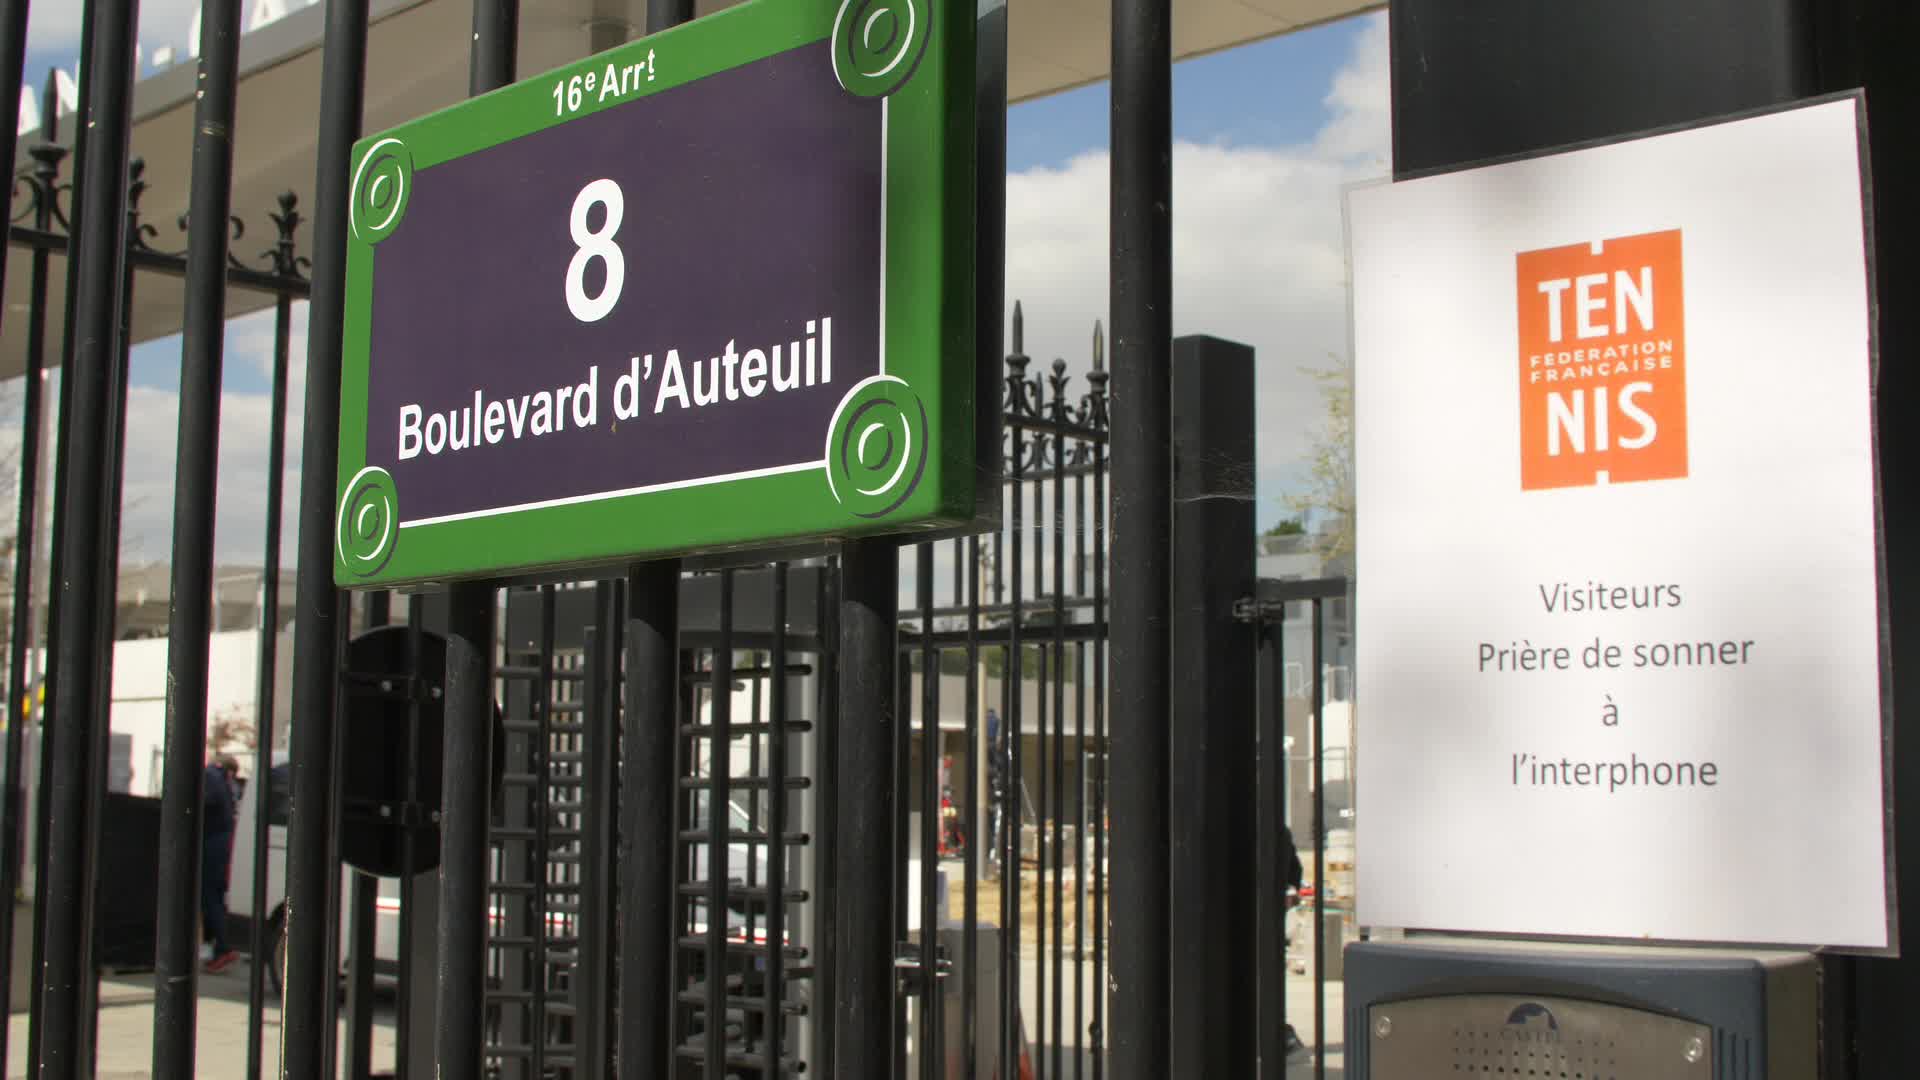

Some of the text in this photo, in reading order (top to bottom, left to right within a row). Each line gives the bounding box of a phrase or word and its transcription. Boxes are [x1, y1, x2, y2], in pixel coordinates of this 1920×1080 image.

[553, 71, 596, 116] 16e
[565, 178, 625, 323] 8
[1537, 266, 1654, 343] TEN
[398, 316, 832, 460] Boulevard d'Auteuil
[1546, 381, 1658, 457] NIS
[1539, 580, 1682, 613] Visiteurs
[1479, 637, 1755, 672] Prière de sonner
[1602, 694, 1619, 727] à
[1511, 753, 1719, 793] l'interphone
